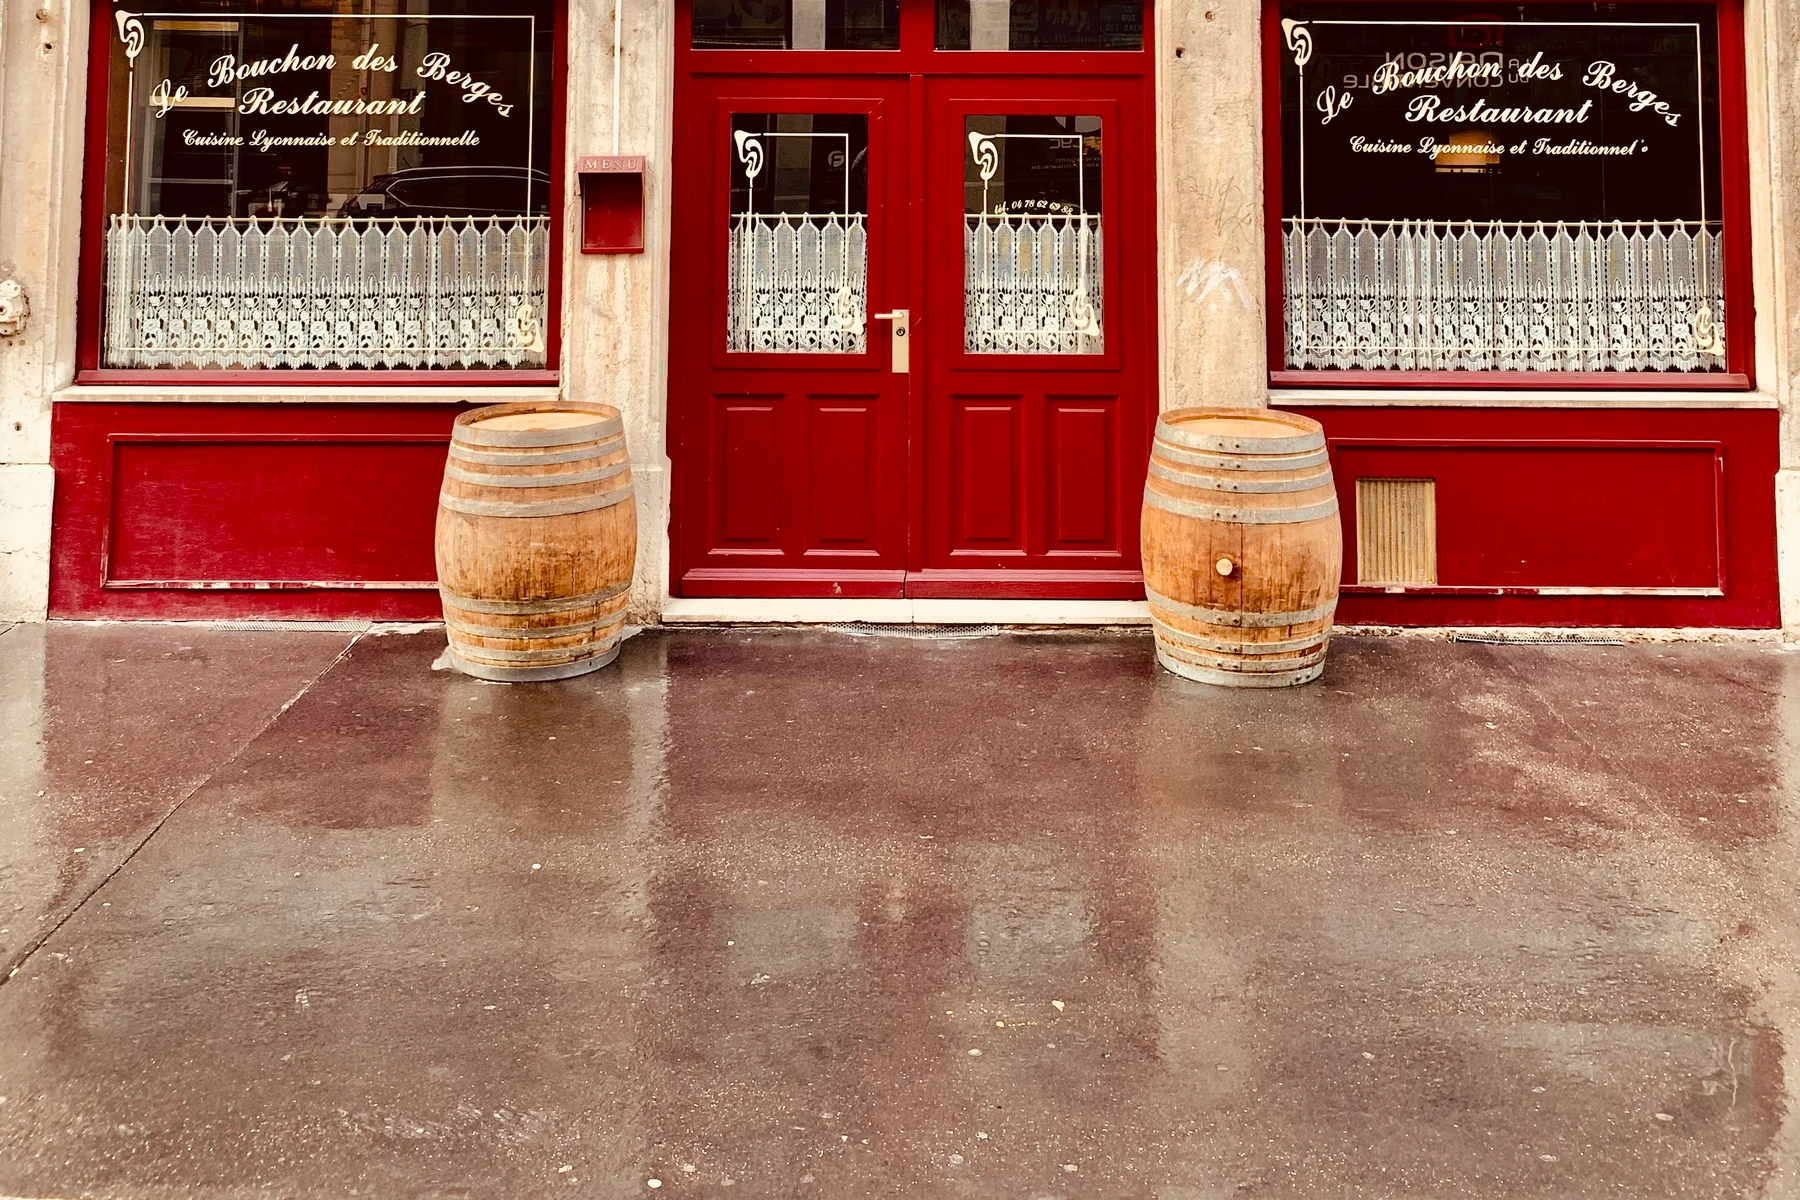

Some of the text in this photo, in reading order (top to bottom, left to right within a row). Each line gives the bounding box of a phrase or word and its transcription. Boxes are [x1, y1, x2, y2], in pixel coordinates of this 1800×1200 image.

[152, 44, 514, 119] Le Bouchon des Berges
[1317, 51, 1682, 127] Le Bouchon des Berges
[239, 88, 427, 115] Restaurant
[1405, 95, 1593, 124] Restaurant
[182, 129, 480, 153] Cuisine Lyonnaise et Traditionnelle
[1349, 135, 1412, 153] Cuisine
[1417, 136, 1506, 159] Lyonnaise
[1510, 139, 1528, 155] et
[584, 159, 638, 170] MENU
[1024, 199, 1036, 208] 78
[1036, 200, 1048, 209] 62
[1049, 202, 1061, 211] 69
